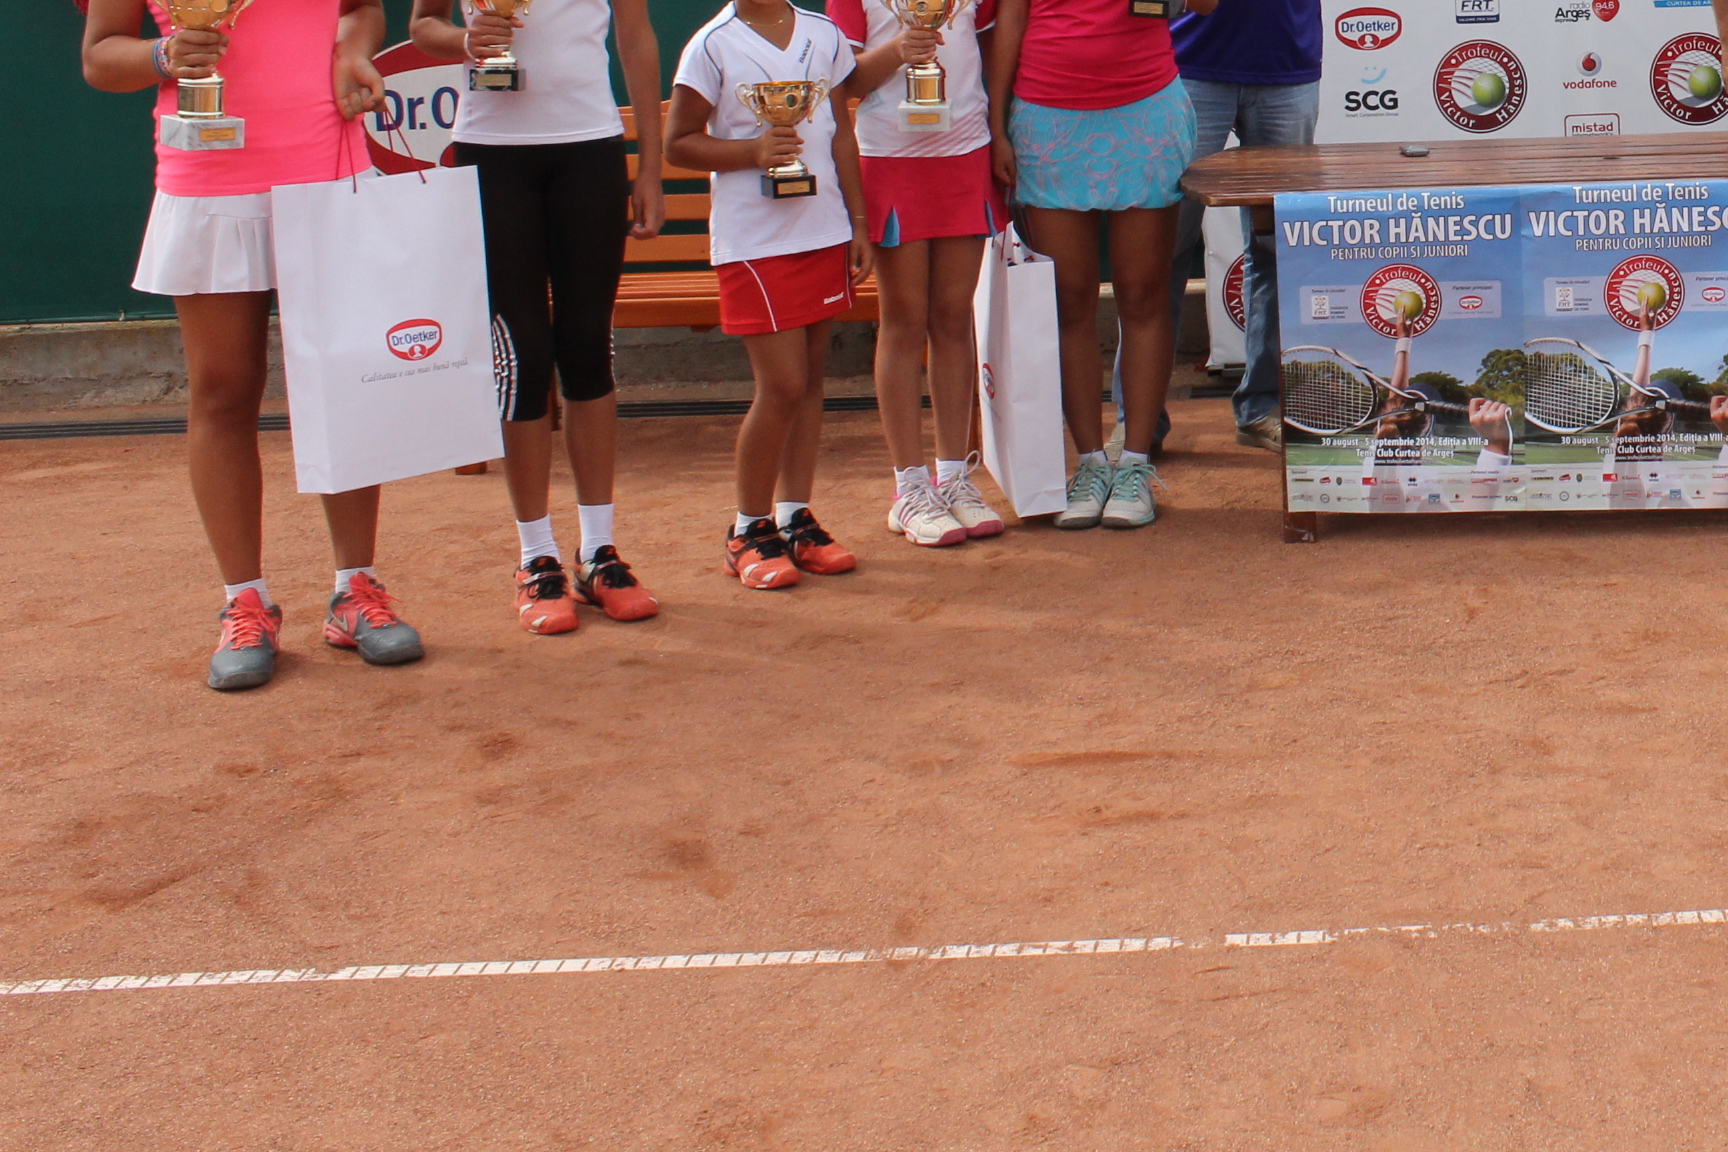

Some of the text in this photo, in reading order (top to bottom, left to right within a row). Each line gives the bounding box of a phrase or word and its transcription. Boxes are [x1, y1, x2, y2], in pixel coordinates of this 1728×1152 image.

[1461, 0, 1494, 11] FRT
[1570, 1, 1590, 9] radio
[1456, 44, 1505, 63] Trofeul
[1672, 37, 1720, 54] Trofeul
[1563, 79, 1617, 89] vodafone
[1345, 90, 1398, 111] SCG
[1657, 85, 1692, 119] Victor
[1439, 93, 1475, 128] Victor
[1571, 122, 1614, 133] mistad
[1573, 182, 1709, 203] Turneul de Tenis
[1328, 191, 1465, 213] Turneul de Tenis
[1283, 212, 1513, 247] VICTOR HĂNESCU
[1528, 210, 1626, 237] VICTOR
[1576, 237, 1620, 251] PENTRU
[1623, 236, 1651, 249] COPII
[1667, 234, 1712, 247] JUNIORI
[1331, 247, 1376, 260] PENTRU
[1378, 246, 1408, 258] COPII
[1423, 245, 1468, 257] JUNIORI
[1378, 268, 1422, 281] Trofeul
[1622, 258, 1666, 274] Trofeul
[1365, 306, 1396, 335] Victor
[1610, 297, 1641, 328] Victor
[1321, 438, 1331, 446] 30
[1332, 438, 1358, 447] august
[1365, 438, 1369, 446] 5
[1371, 437, 1413, 448] septembrie
[1416, 437, 1437, 447] 2014,
[1356, 449, 1375, 457] Tenis
[1377, 449, 1393, 457] Club
[1395, 449, 1420, 457] Curtea
[1422, 449, 1431, 457] de
